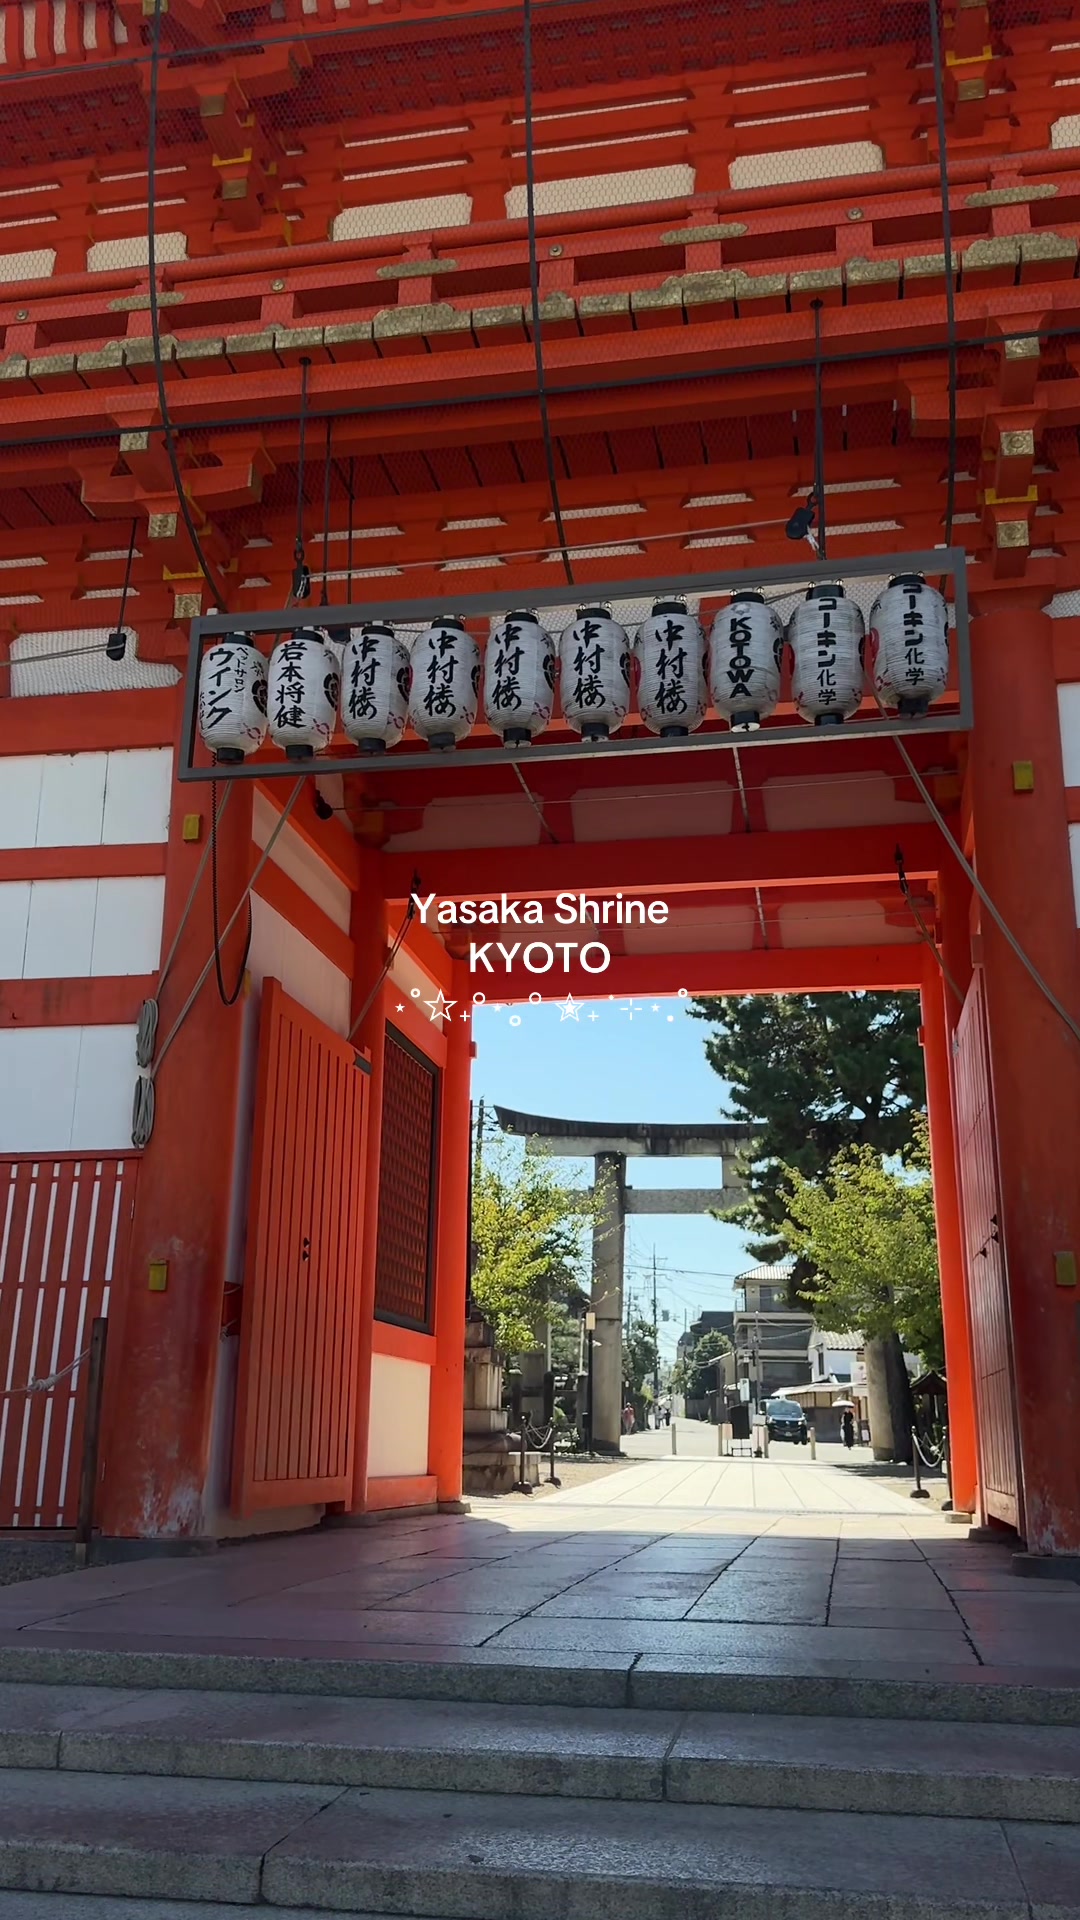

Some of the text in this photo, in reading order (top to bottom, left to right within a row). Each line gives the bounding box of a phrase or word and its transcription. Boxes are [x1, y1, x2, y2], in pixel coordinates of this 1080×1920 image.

[726, 617, 755, 699] KOTOWA
[816, 598, 837, 706] コーキン化学
[902, 584, 925, 686] コーキン化学
[273, 641, 308, 729] 岩本将健
